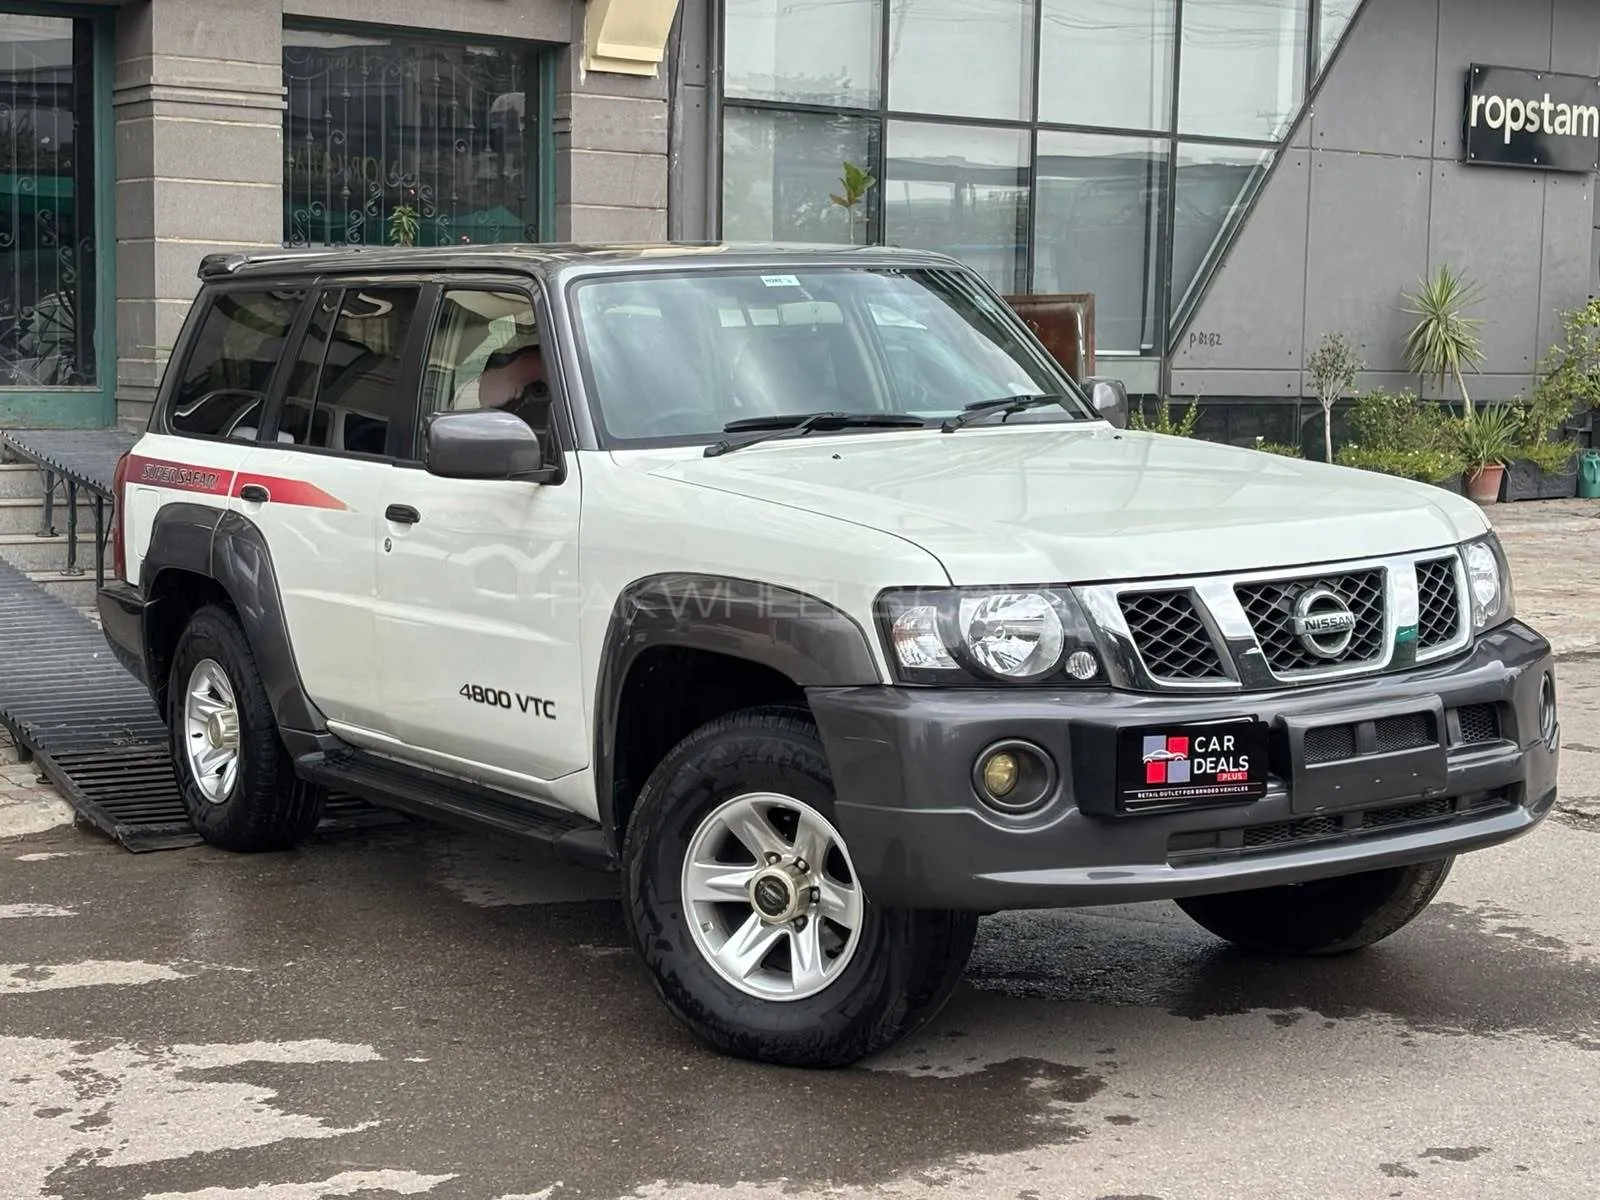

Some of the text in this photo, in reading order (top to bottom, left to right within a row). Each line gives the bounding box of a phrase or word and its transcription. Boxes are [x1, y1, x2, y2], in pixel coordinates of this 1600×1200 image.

[1471, 93, 1599, 144] ropstam
[141, 463, 221, 489] SUPER SAFARI
[1304, 615, 1353, 630] NISSAN
[459, 683, 556, 720] 4800 VTC
[1194, 735, 1235, 753] CAR
[1193, 755, 1249, 774] DEALS
[1222, 773, 1244, 781] PLUS
[1137, 791, 1159, 799] RETAIL
[1159, 789, 1182, 797] OUTLET
[1182, 788, 1195, 796] FOR
[1219, 785, 1249, 793] VEHICLES
